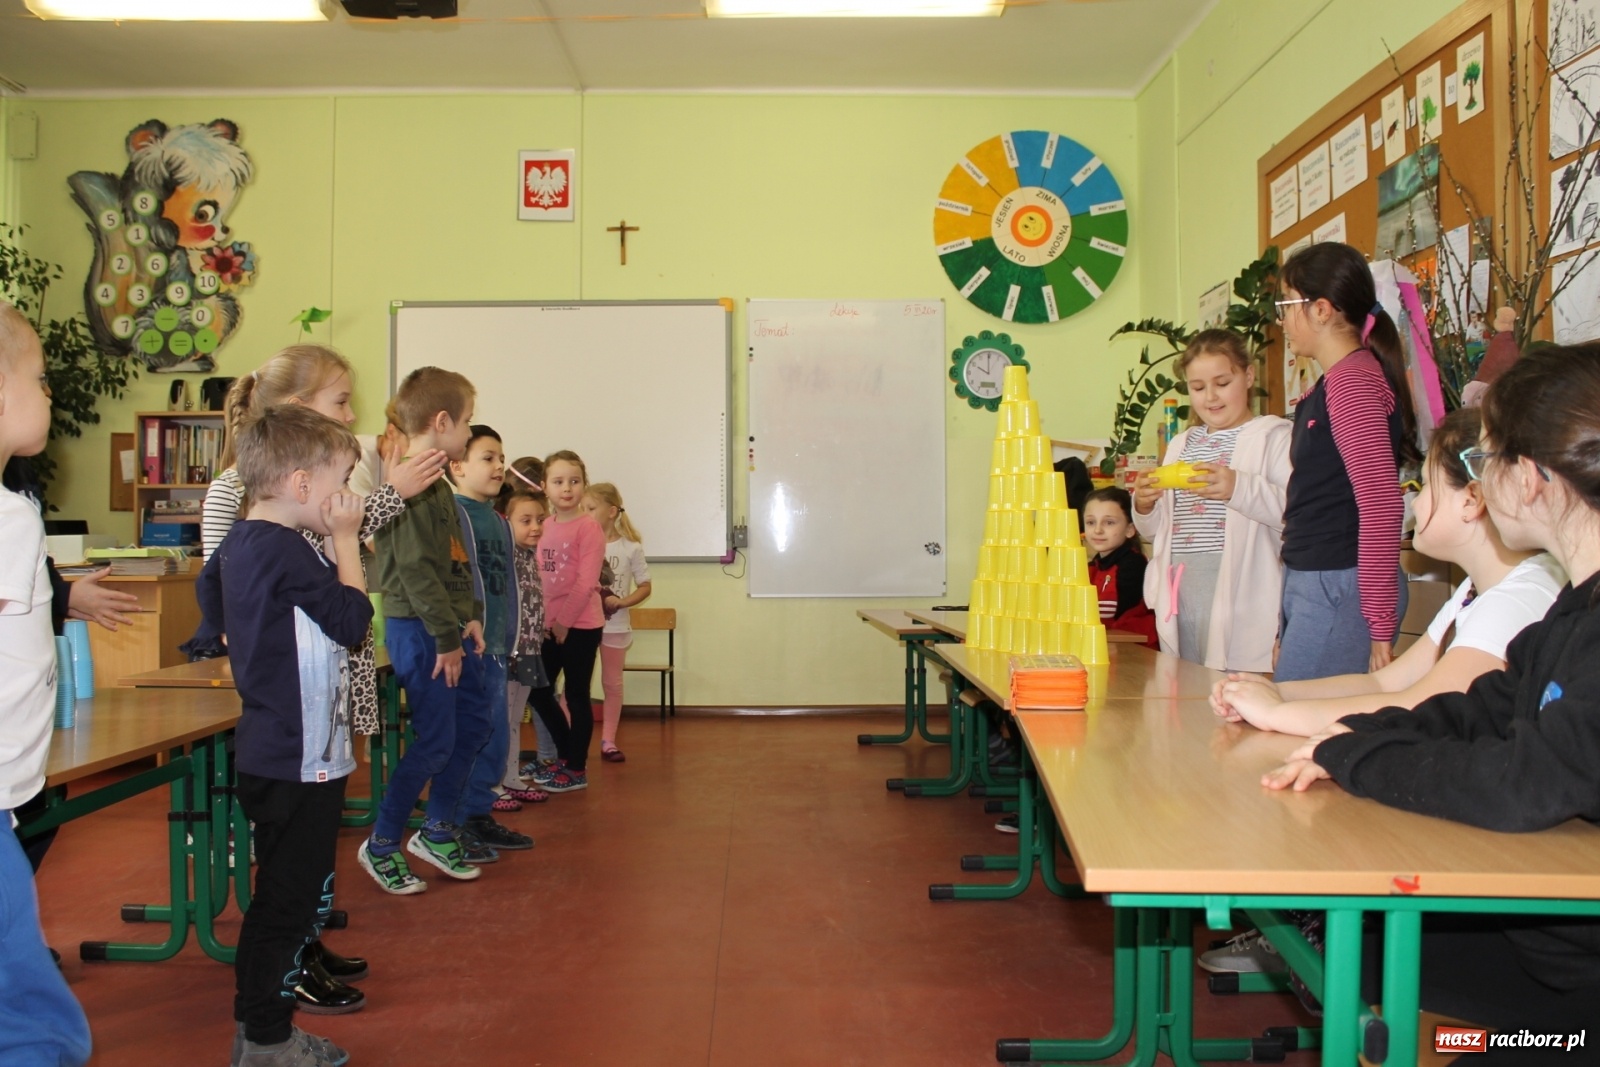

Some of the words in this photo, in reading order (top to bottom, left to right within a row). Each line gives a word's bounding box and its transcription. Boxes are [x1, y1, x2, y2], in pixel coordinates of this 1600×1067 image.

[140, 197, 148, 209] 8
[1035, 190, 1057, 206] ZIMA
[107, 214, 115, 227] 5
[134, 228, 142, 239] 1
[1047, 224, 1069, 259] WIOSNA
[1002, 245, 1026, 263] LATO
[117, 258, 125, 270] 2
[151, 258, 159, 270] 6
[200, 276, 216, 288] 10
[101, 288, 109, 299] 4
[137, 289, 145, 301] 3
[175, 288, 183, 299] 9
[196, 310, 204, 322] 0
[121, 321, 129, 333] 7
[1001, 336, 1007, 344] 5
